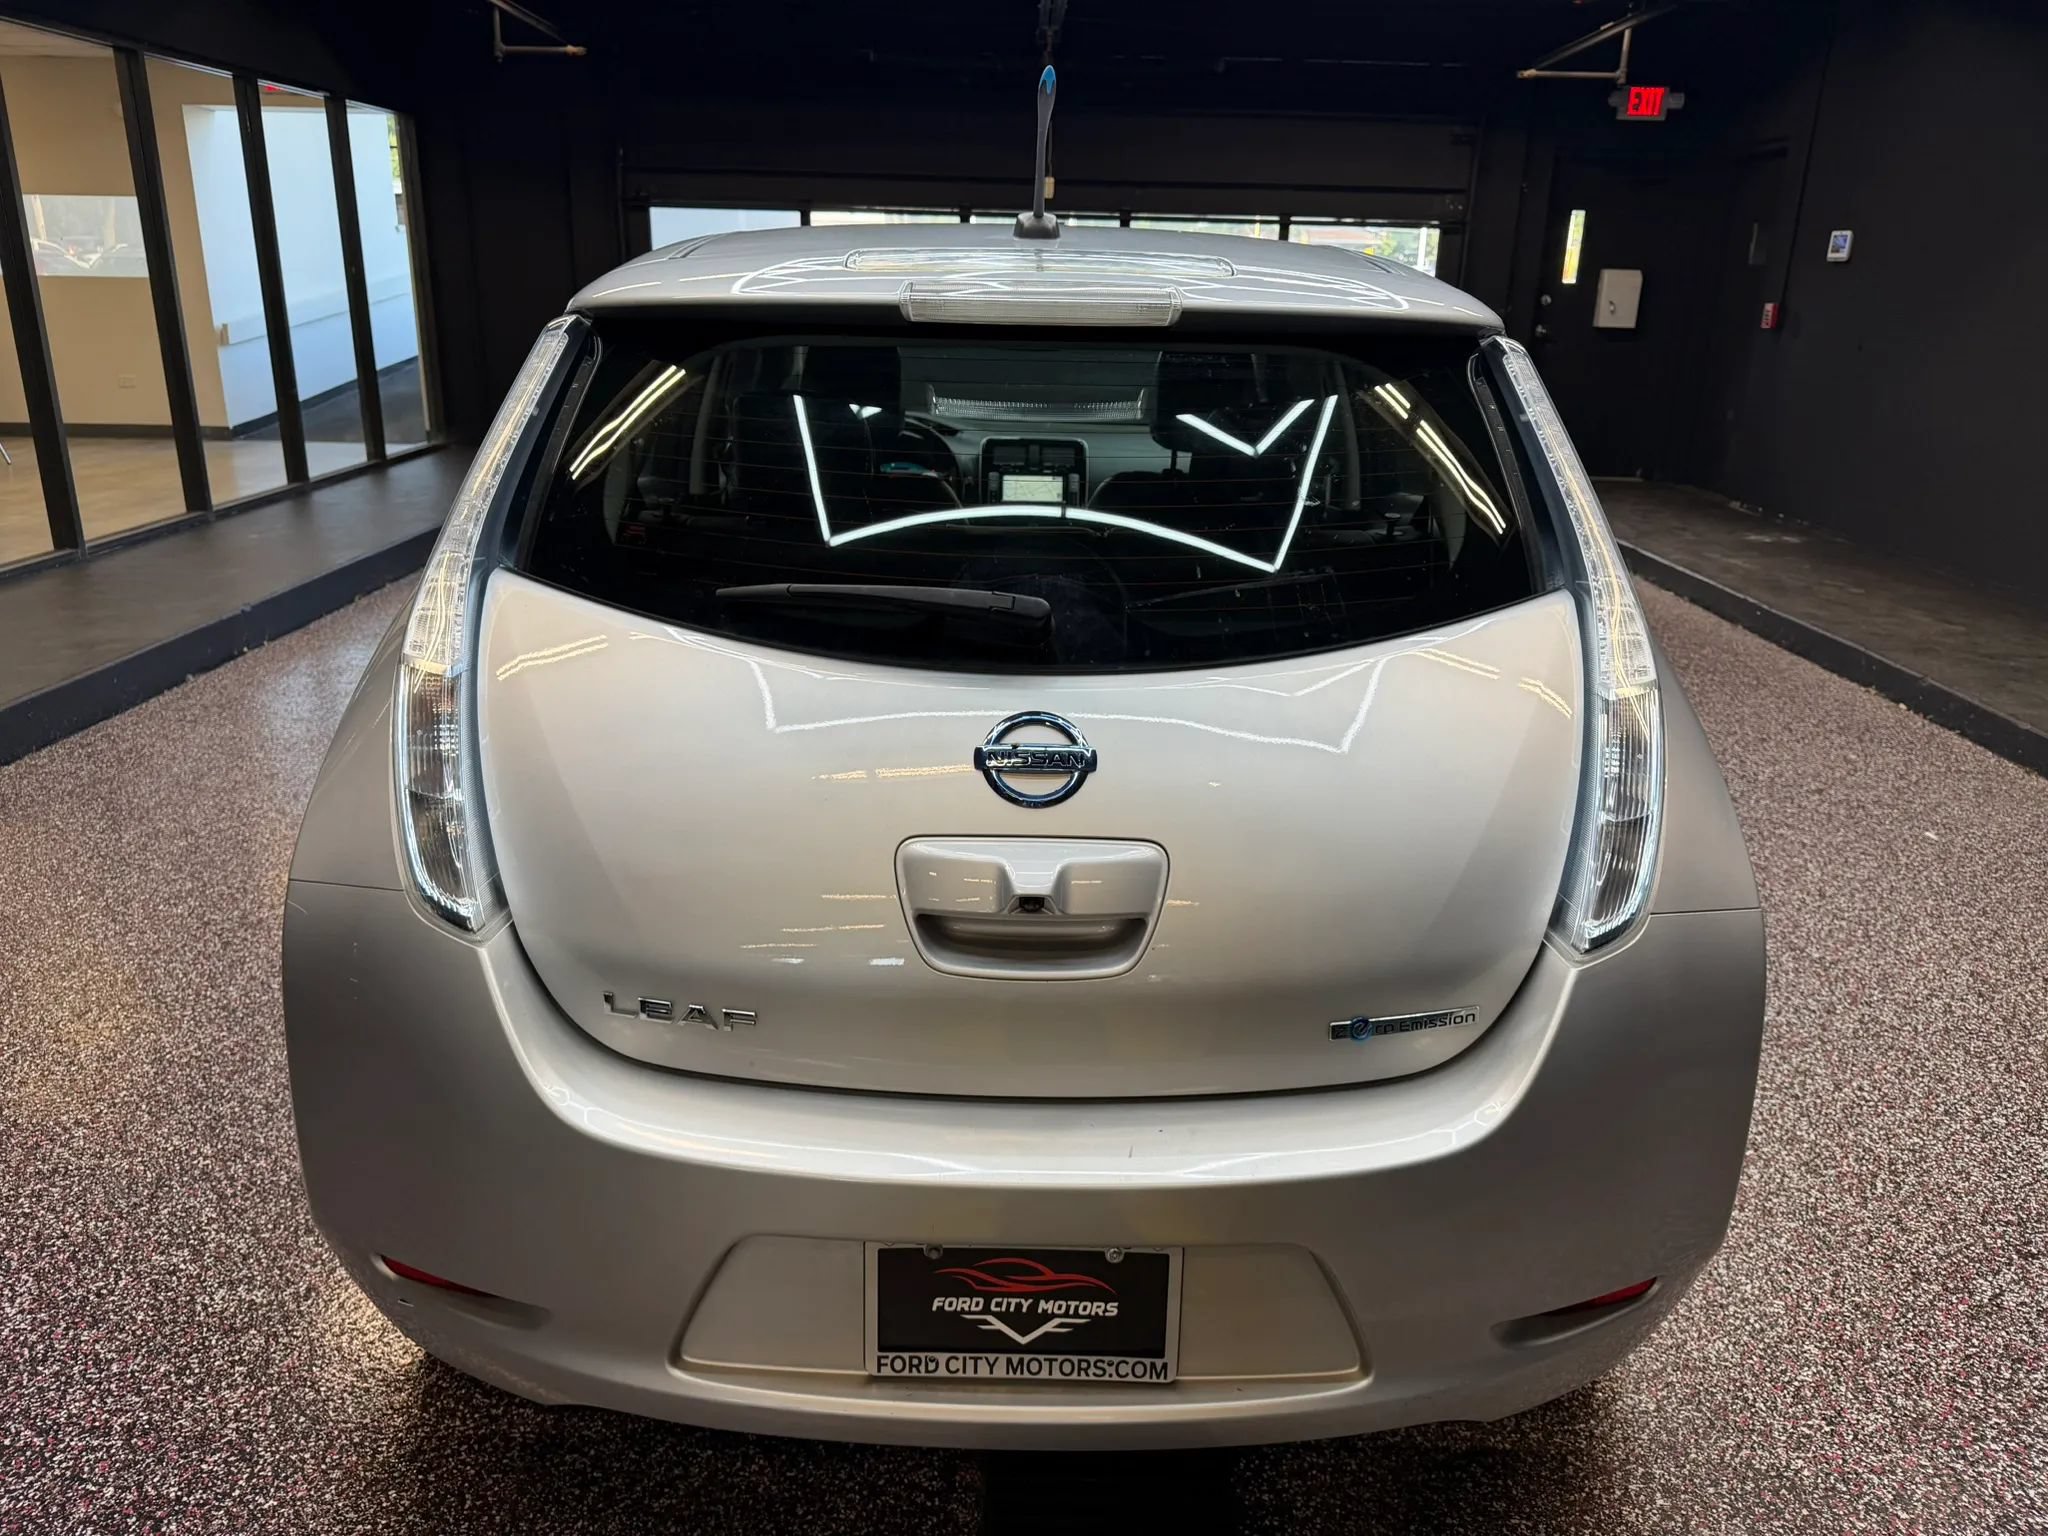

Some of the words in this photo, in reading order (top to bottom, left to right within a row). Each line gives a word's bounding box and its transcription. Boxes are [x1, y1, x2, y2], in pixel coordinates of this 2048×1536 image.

[1627, 87, 1665, 116] EXIT
[986, 751, 1086, 769] NISSAN
[603, 991, 757, 1032] LEAF
[1400, 1012, 1476, 1033] Emission
[931, 1297, 984, 1313] FORD
[990, 1298, 1033, 1314] CITY
[1038, 1300, 1119, 1317] MOTORS
[876, 1355, 939, 1375] FORD
[945, 1356, 999, 1376] CITY
